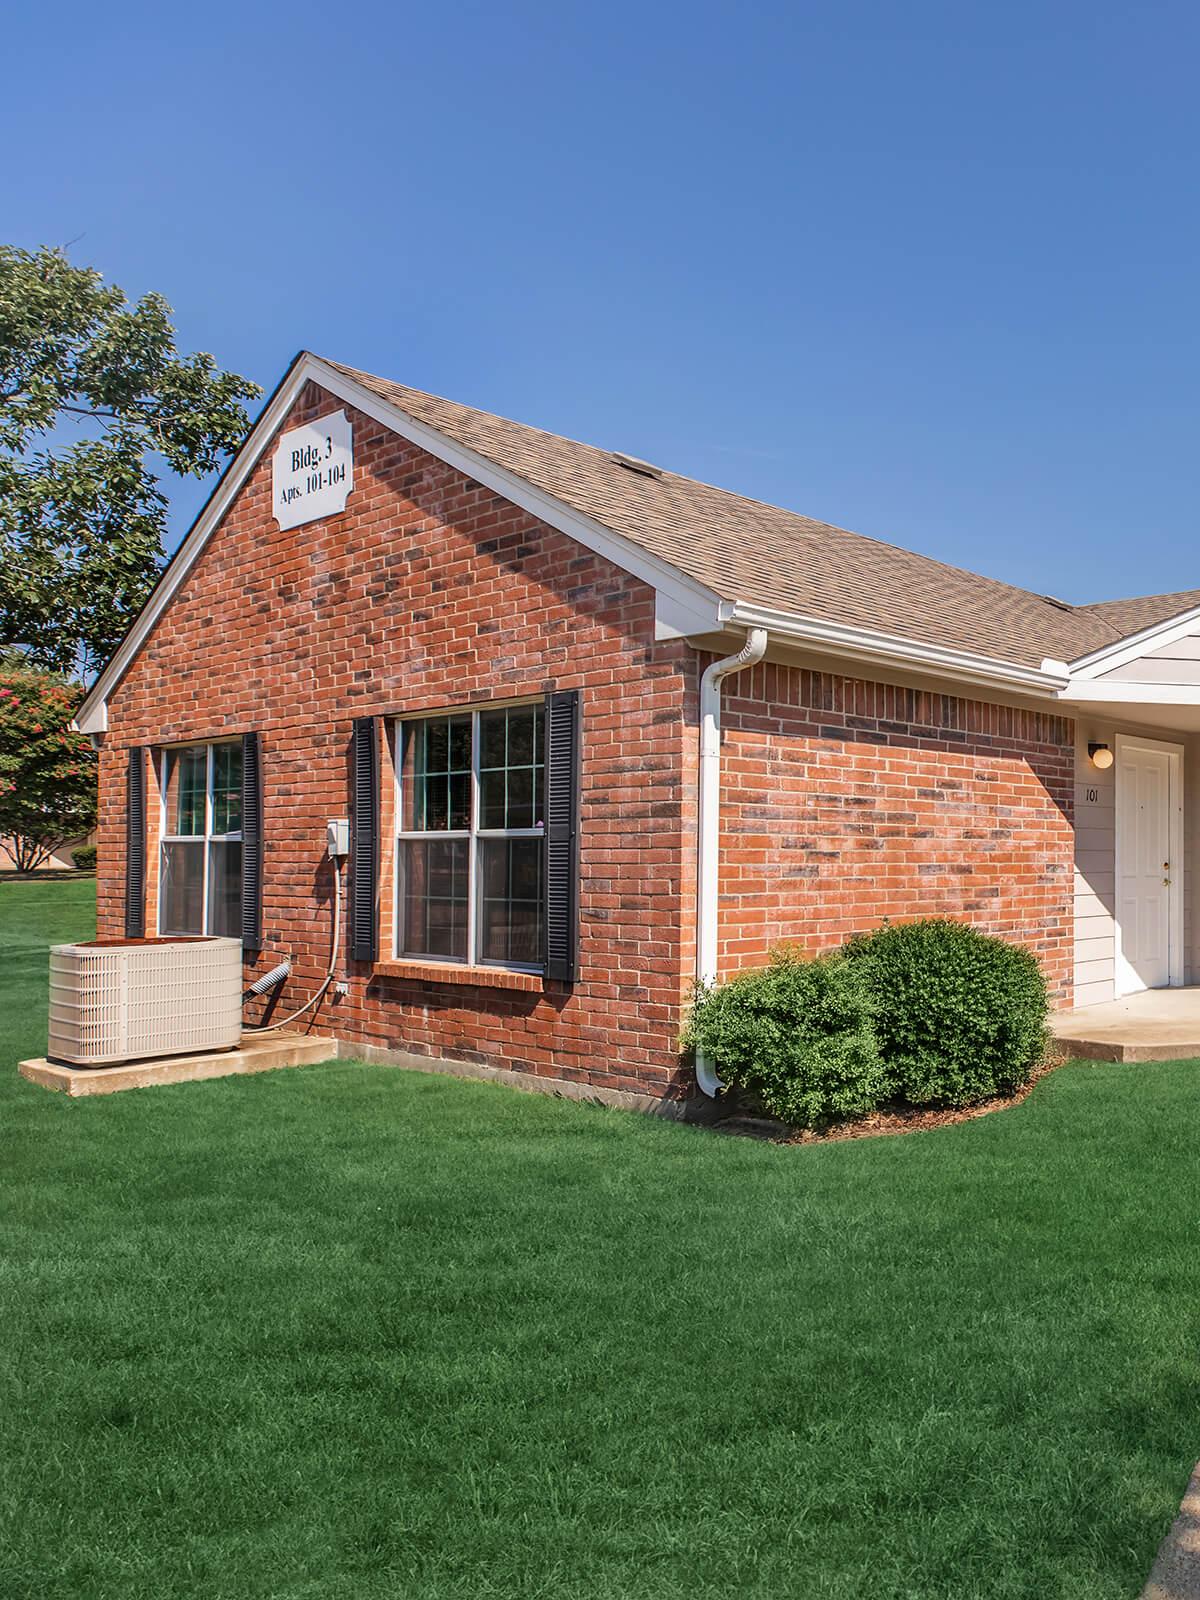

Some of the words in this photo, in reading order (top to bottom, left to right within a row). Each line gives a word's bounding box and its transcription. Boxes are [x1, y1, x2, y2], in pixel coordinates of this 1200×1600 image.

[291, 445, 322, 472] Bldg.
[325, 436, 332, 459] 3
[280, 485, 302, 504] Apts.
[306, 463, 345, 494] 101-104
[1086, 789, 1098, 802] 101
